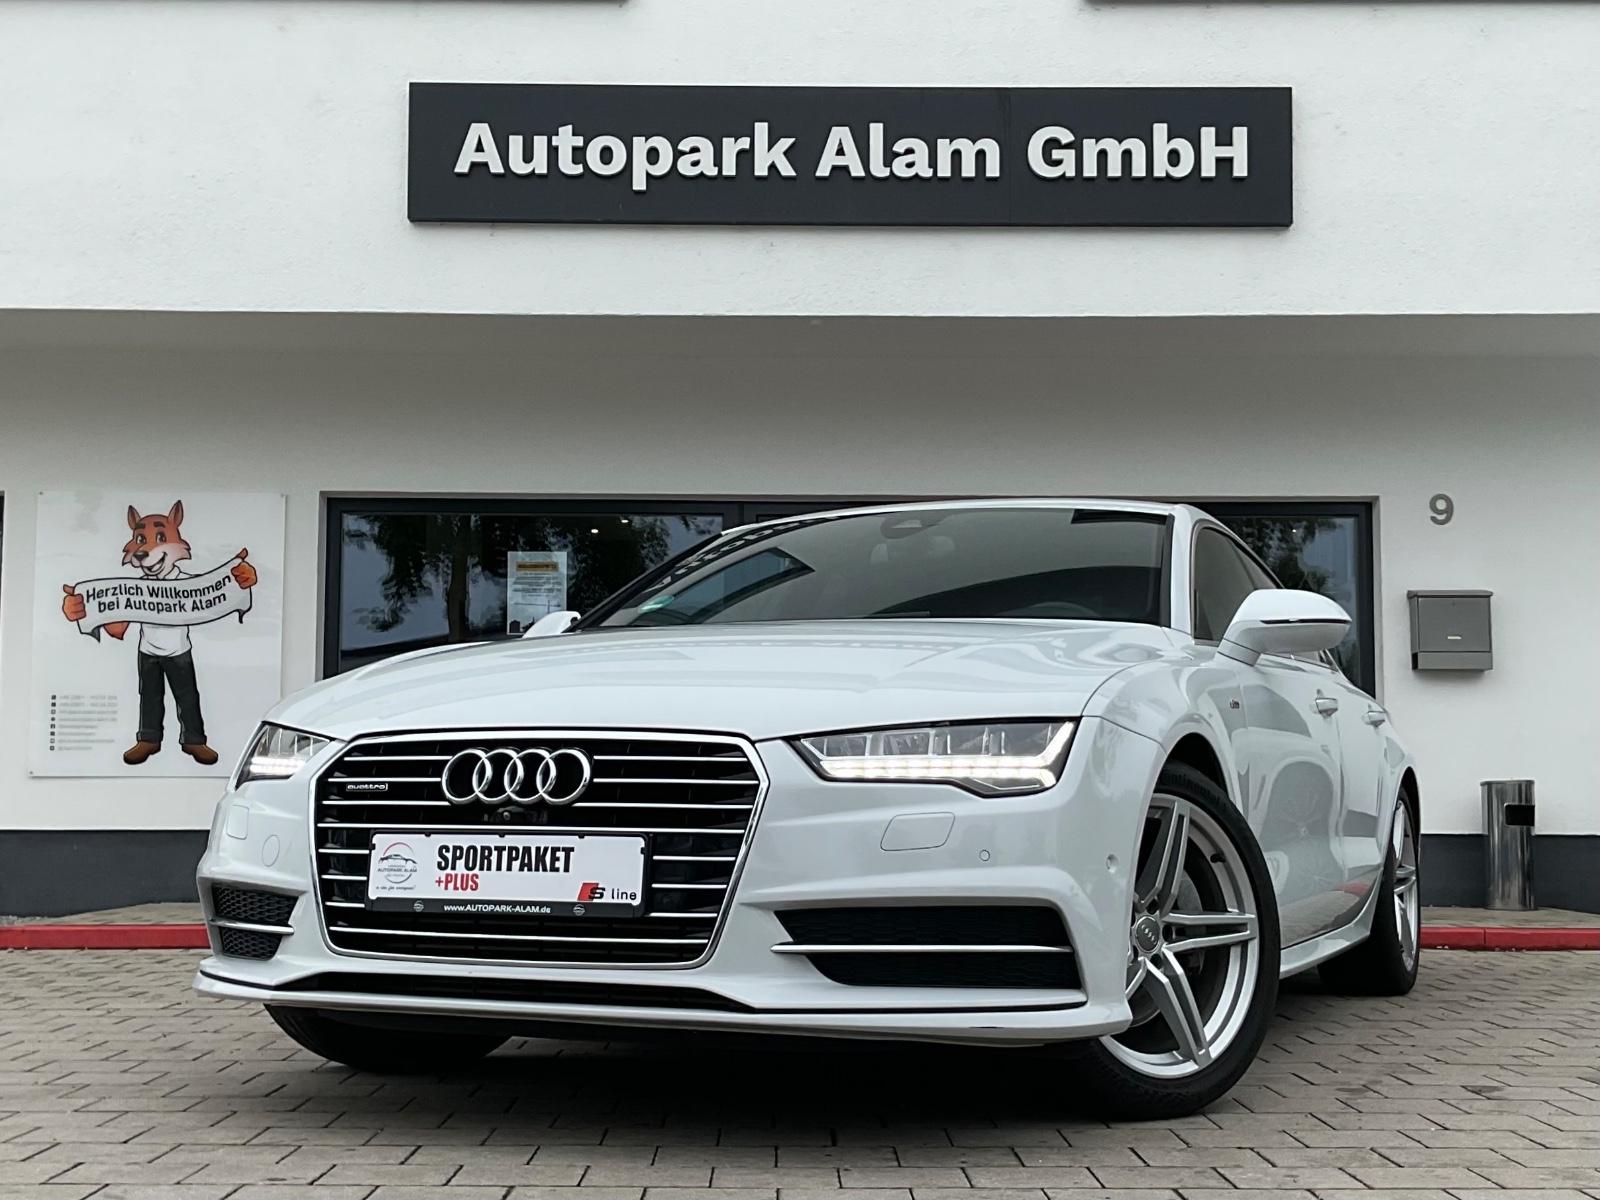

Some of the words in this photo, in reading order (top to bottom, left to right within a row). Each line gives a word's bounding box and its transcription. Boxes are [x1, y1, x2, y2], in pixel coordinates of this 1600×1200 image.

[454, 122, 797, 191] Autopark
[815, 123, 1000, 178] Alam
[1027, 123, 1248, 178] GmbH
[1429, 493, 1454, 526] 9
[86, 584, 143, 603] Herzlich
[147, 575, 232, 600] Willkommen
[98, 598, 120, 613] bei
[124, 597, 189, 614] Autopark
[191, 593, 226, 612] Alam
[437, 845, 575, 873] SPORTPAKET
[436, 873, 479, 891] +PLUS
[611, 888, 637, 901] line
[443, 904, 551, 914] www.AUTOPARK-ALAM.de
